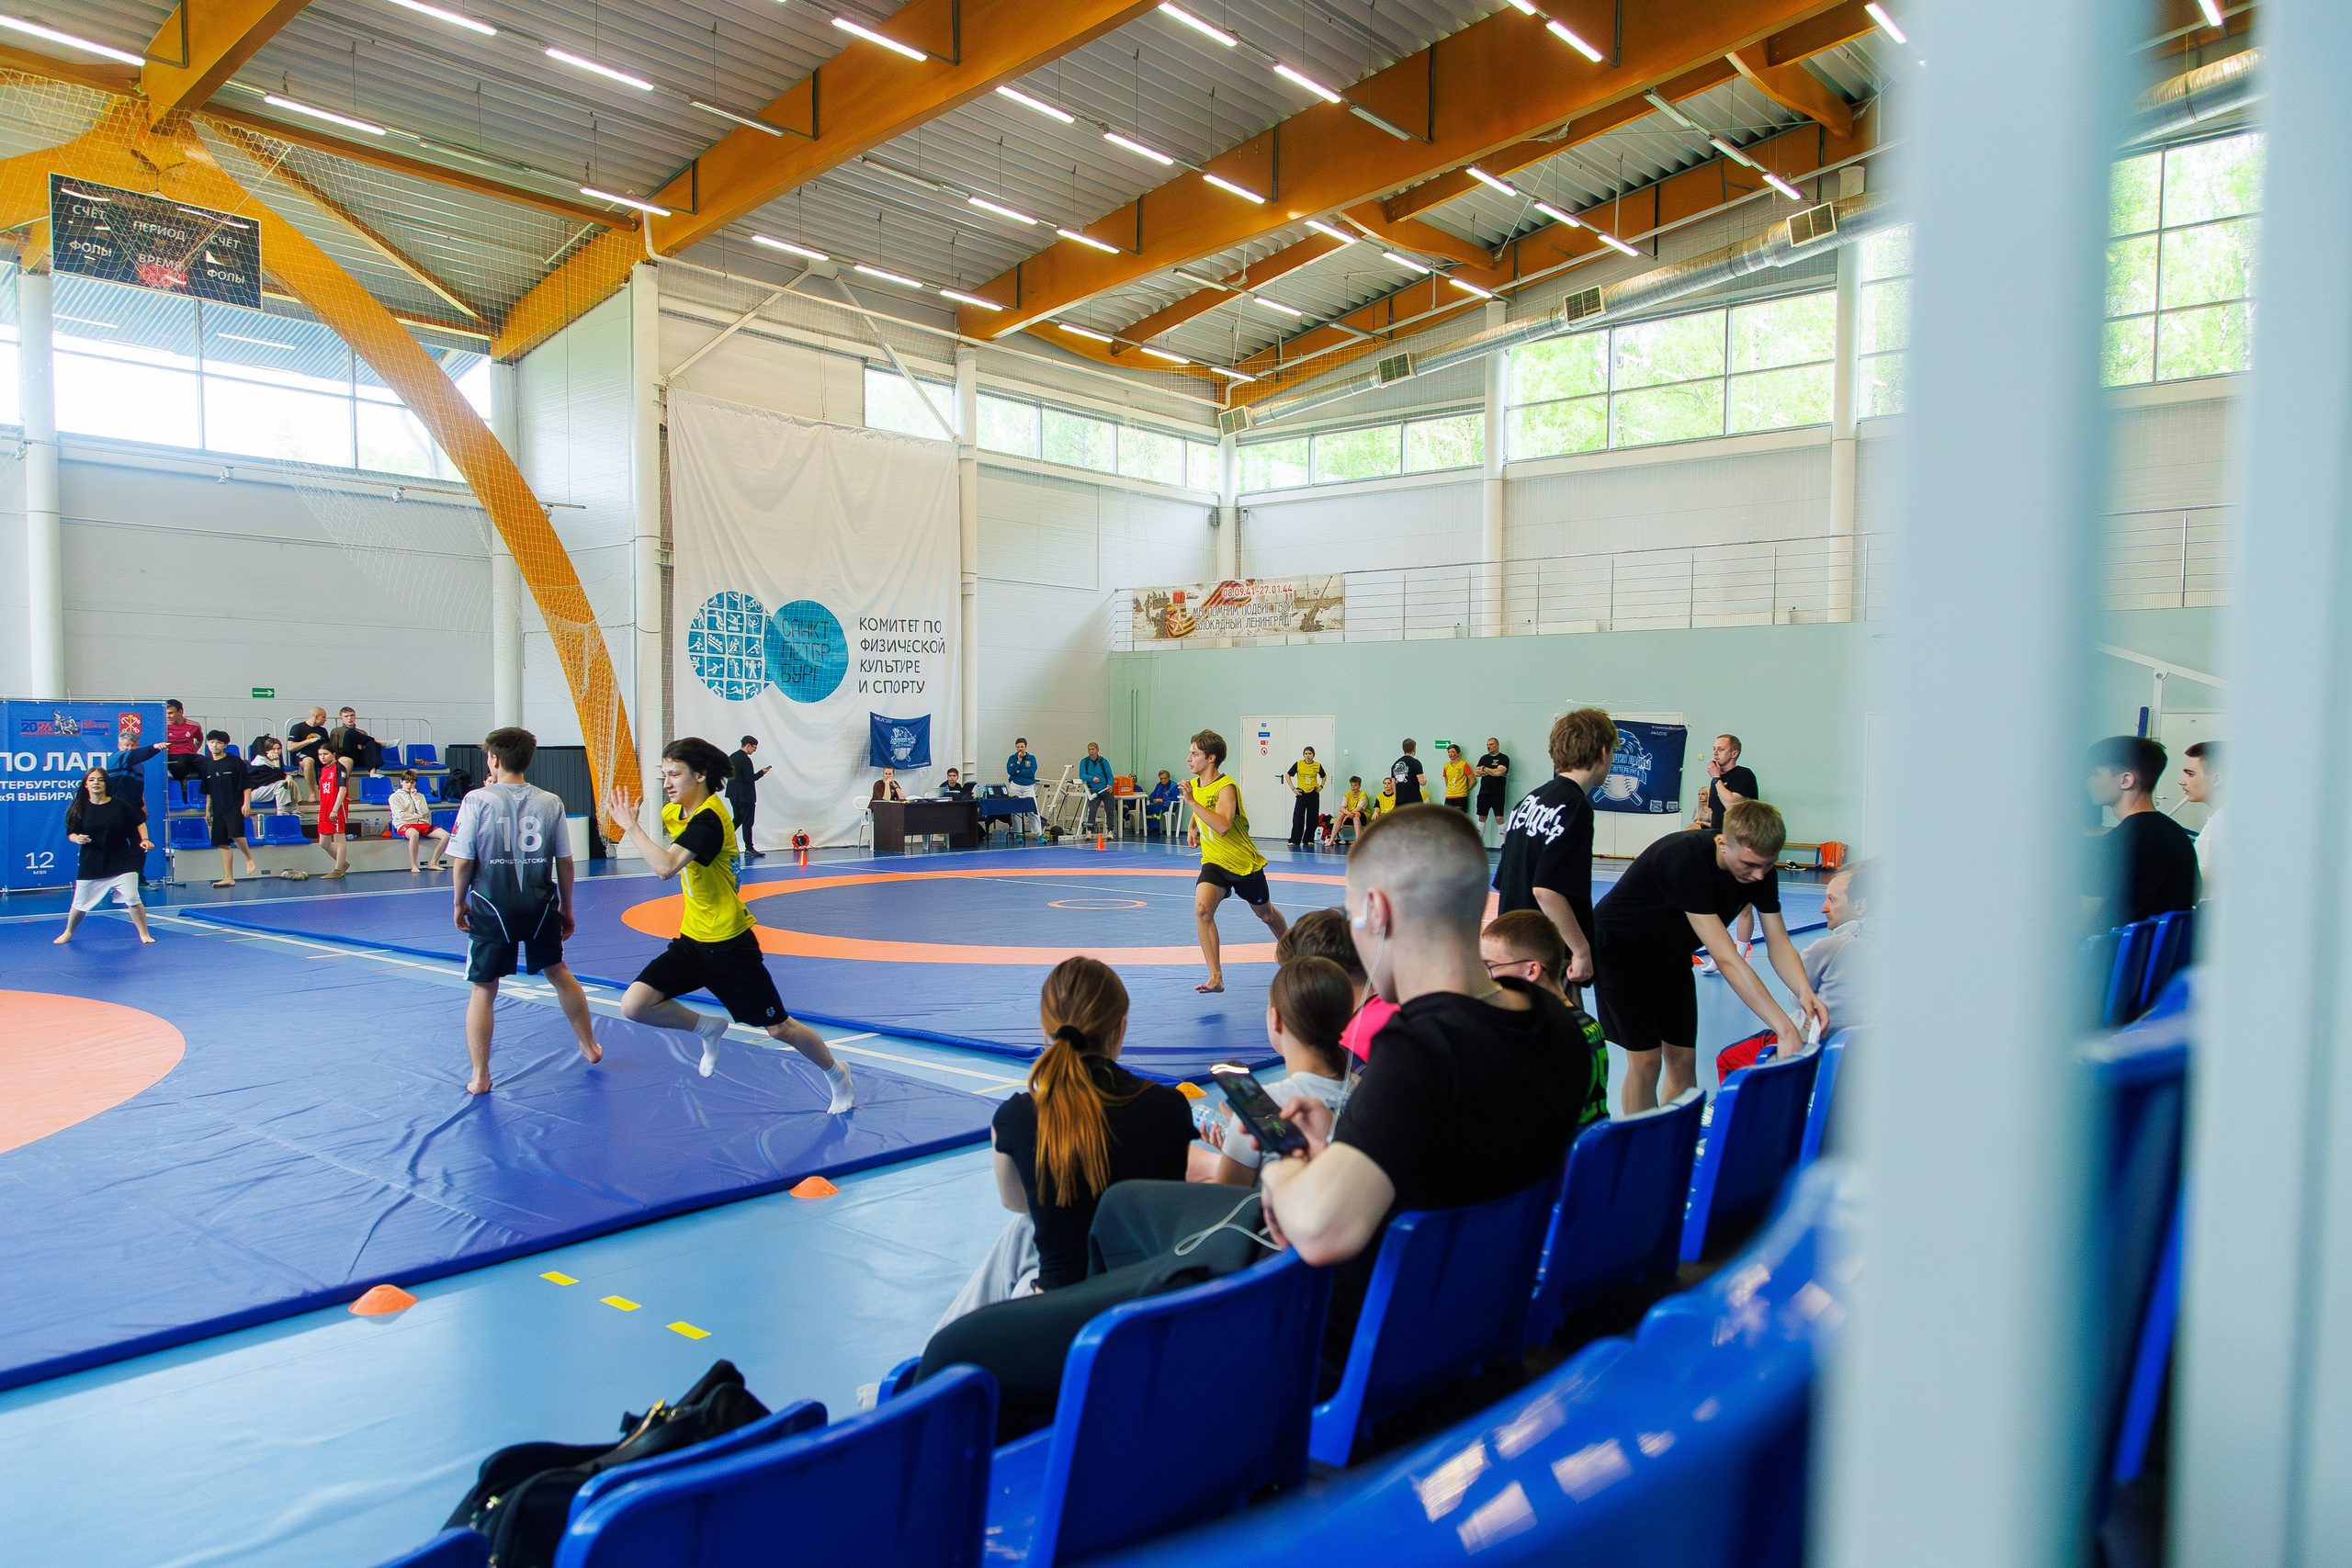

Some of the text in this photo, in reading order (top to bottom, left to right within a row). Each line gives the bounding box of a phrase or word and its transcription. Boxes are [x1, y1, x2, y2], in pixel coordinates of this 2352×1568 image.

[133, 220, 186, 242] ПЕРИОД
[69, 240, 112, 258] ФОЛЫ
[138, 253, 182, 272] ВРЕМЯ
[207, 269, 245, 285] ФОЛЫ
[1223, 584, 1293, 597] 08.09.41-27.01.44
[1193, 606, 1205, 617] МЫ
[1208, 604, 1238, 616] ПОМНИМ
[1242, 603, 1270, 615] ПОДВИГ
[782, 618, 830, 639] САНКТ
[859, 617, 942, 634] КОМИТЕТ ПО
[1195, 615, 1292, 630] БЛОКАДНЫЙ ЛЕНИНГРАД!
[782, 640, 831, 662] ПЕТЕР
[860, 637, 945, 654] ФИЗИЧЕСКОЙ
[781, 663, 823, 684] БУРГ
[860, 659, 920, 673] КУЛЬТУРЕ
[858, 680, 925, 694] И СПОРТУ
[21, 722, 53, 733] 2026
[42, 751, 114, 772] ЛАП
[17, 791, 78, 802] ВЫБИРА
[496, 816, 543, 852] 18
[25, 851, 55, 869] 12
